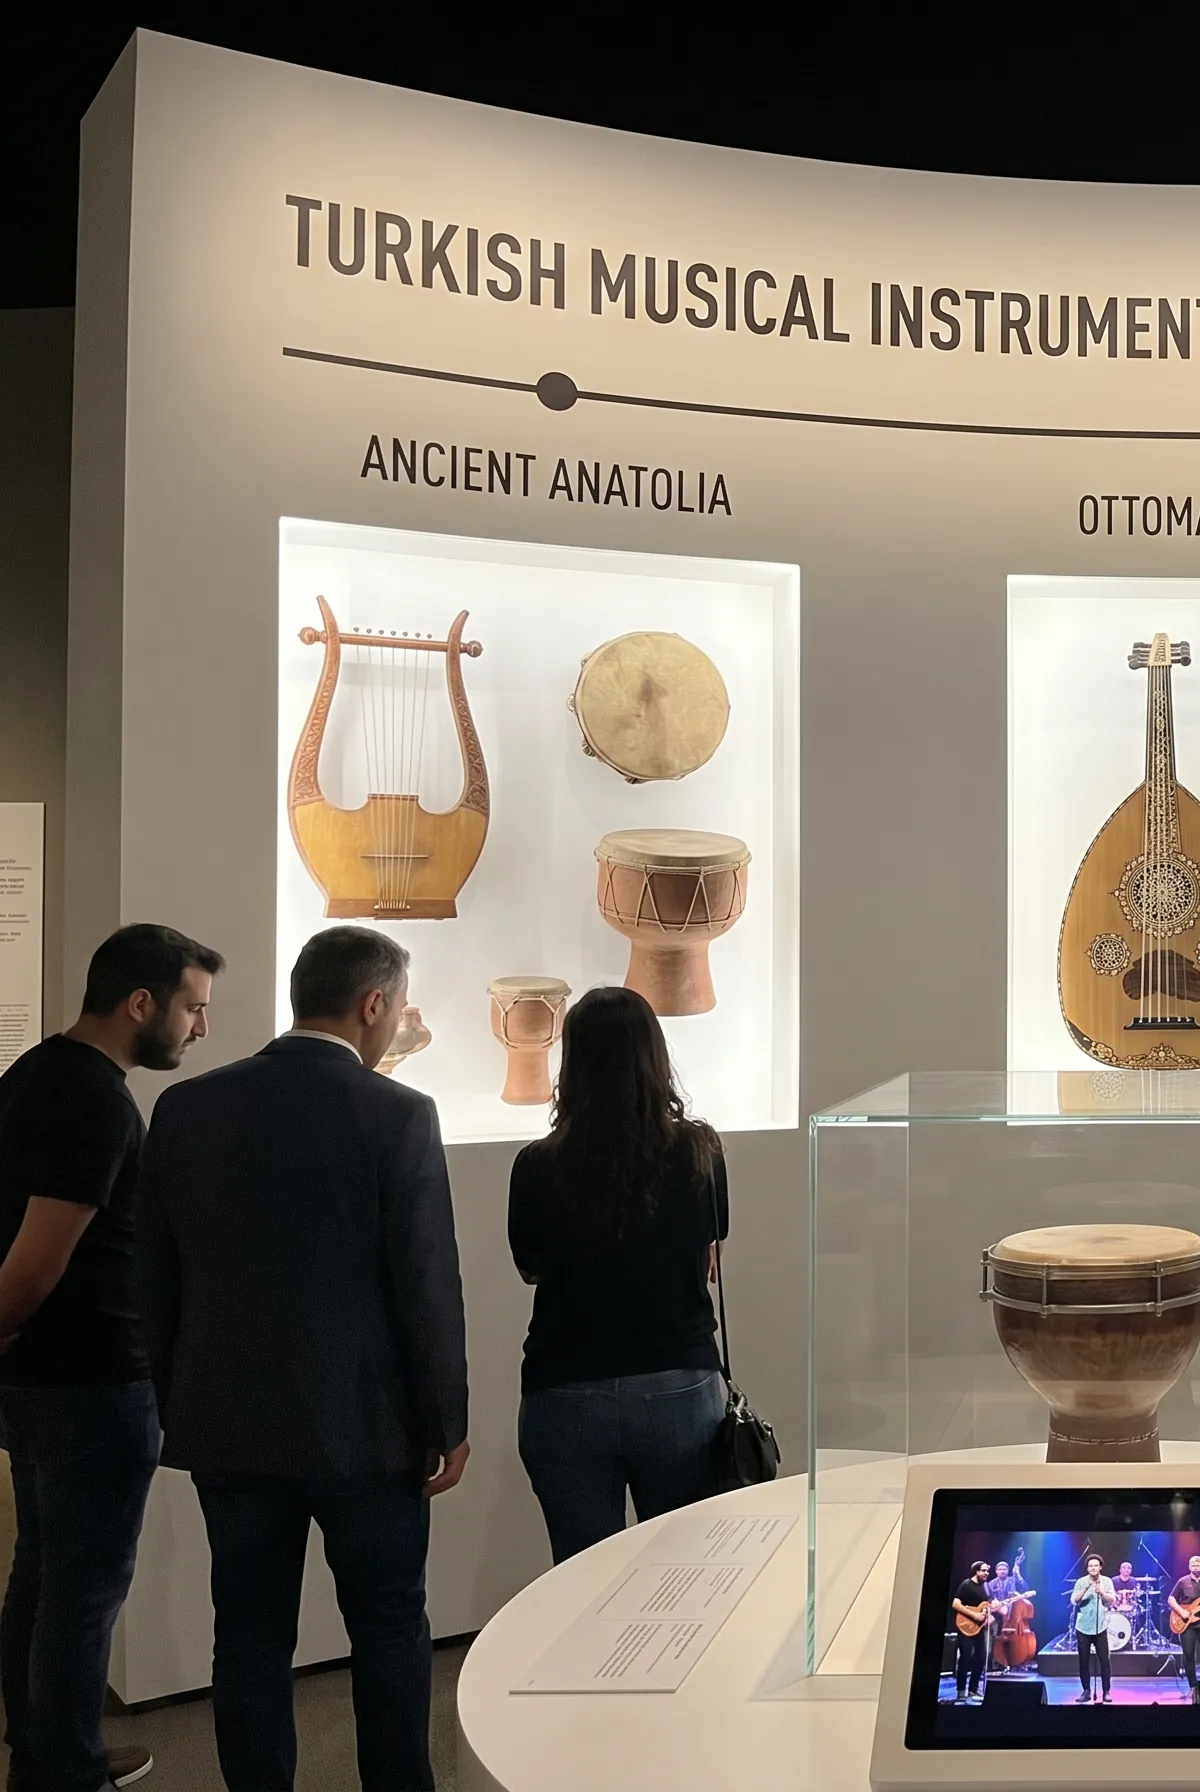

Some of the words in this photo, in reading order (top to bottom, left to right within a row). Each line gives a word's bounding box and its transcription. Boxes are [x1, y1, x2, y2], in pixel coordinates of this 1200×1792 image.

[285, 194, 565, 310] TURKISH
[590, 248, 851, 343] MUSICAL
[360, 434, 537, 497] ANCIENT
[548, 457, 733, 516] ANATOLIA
